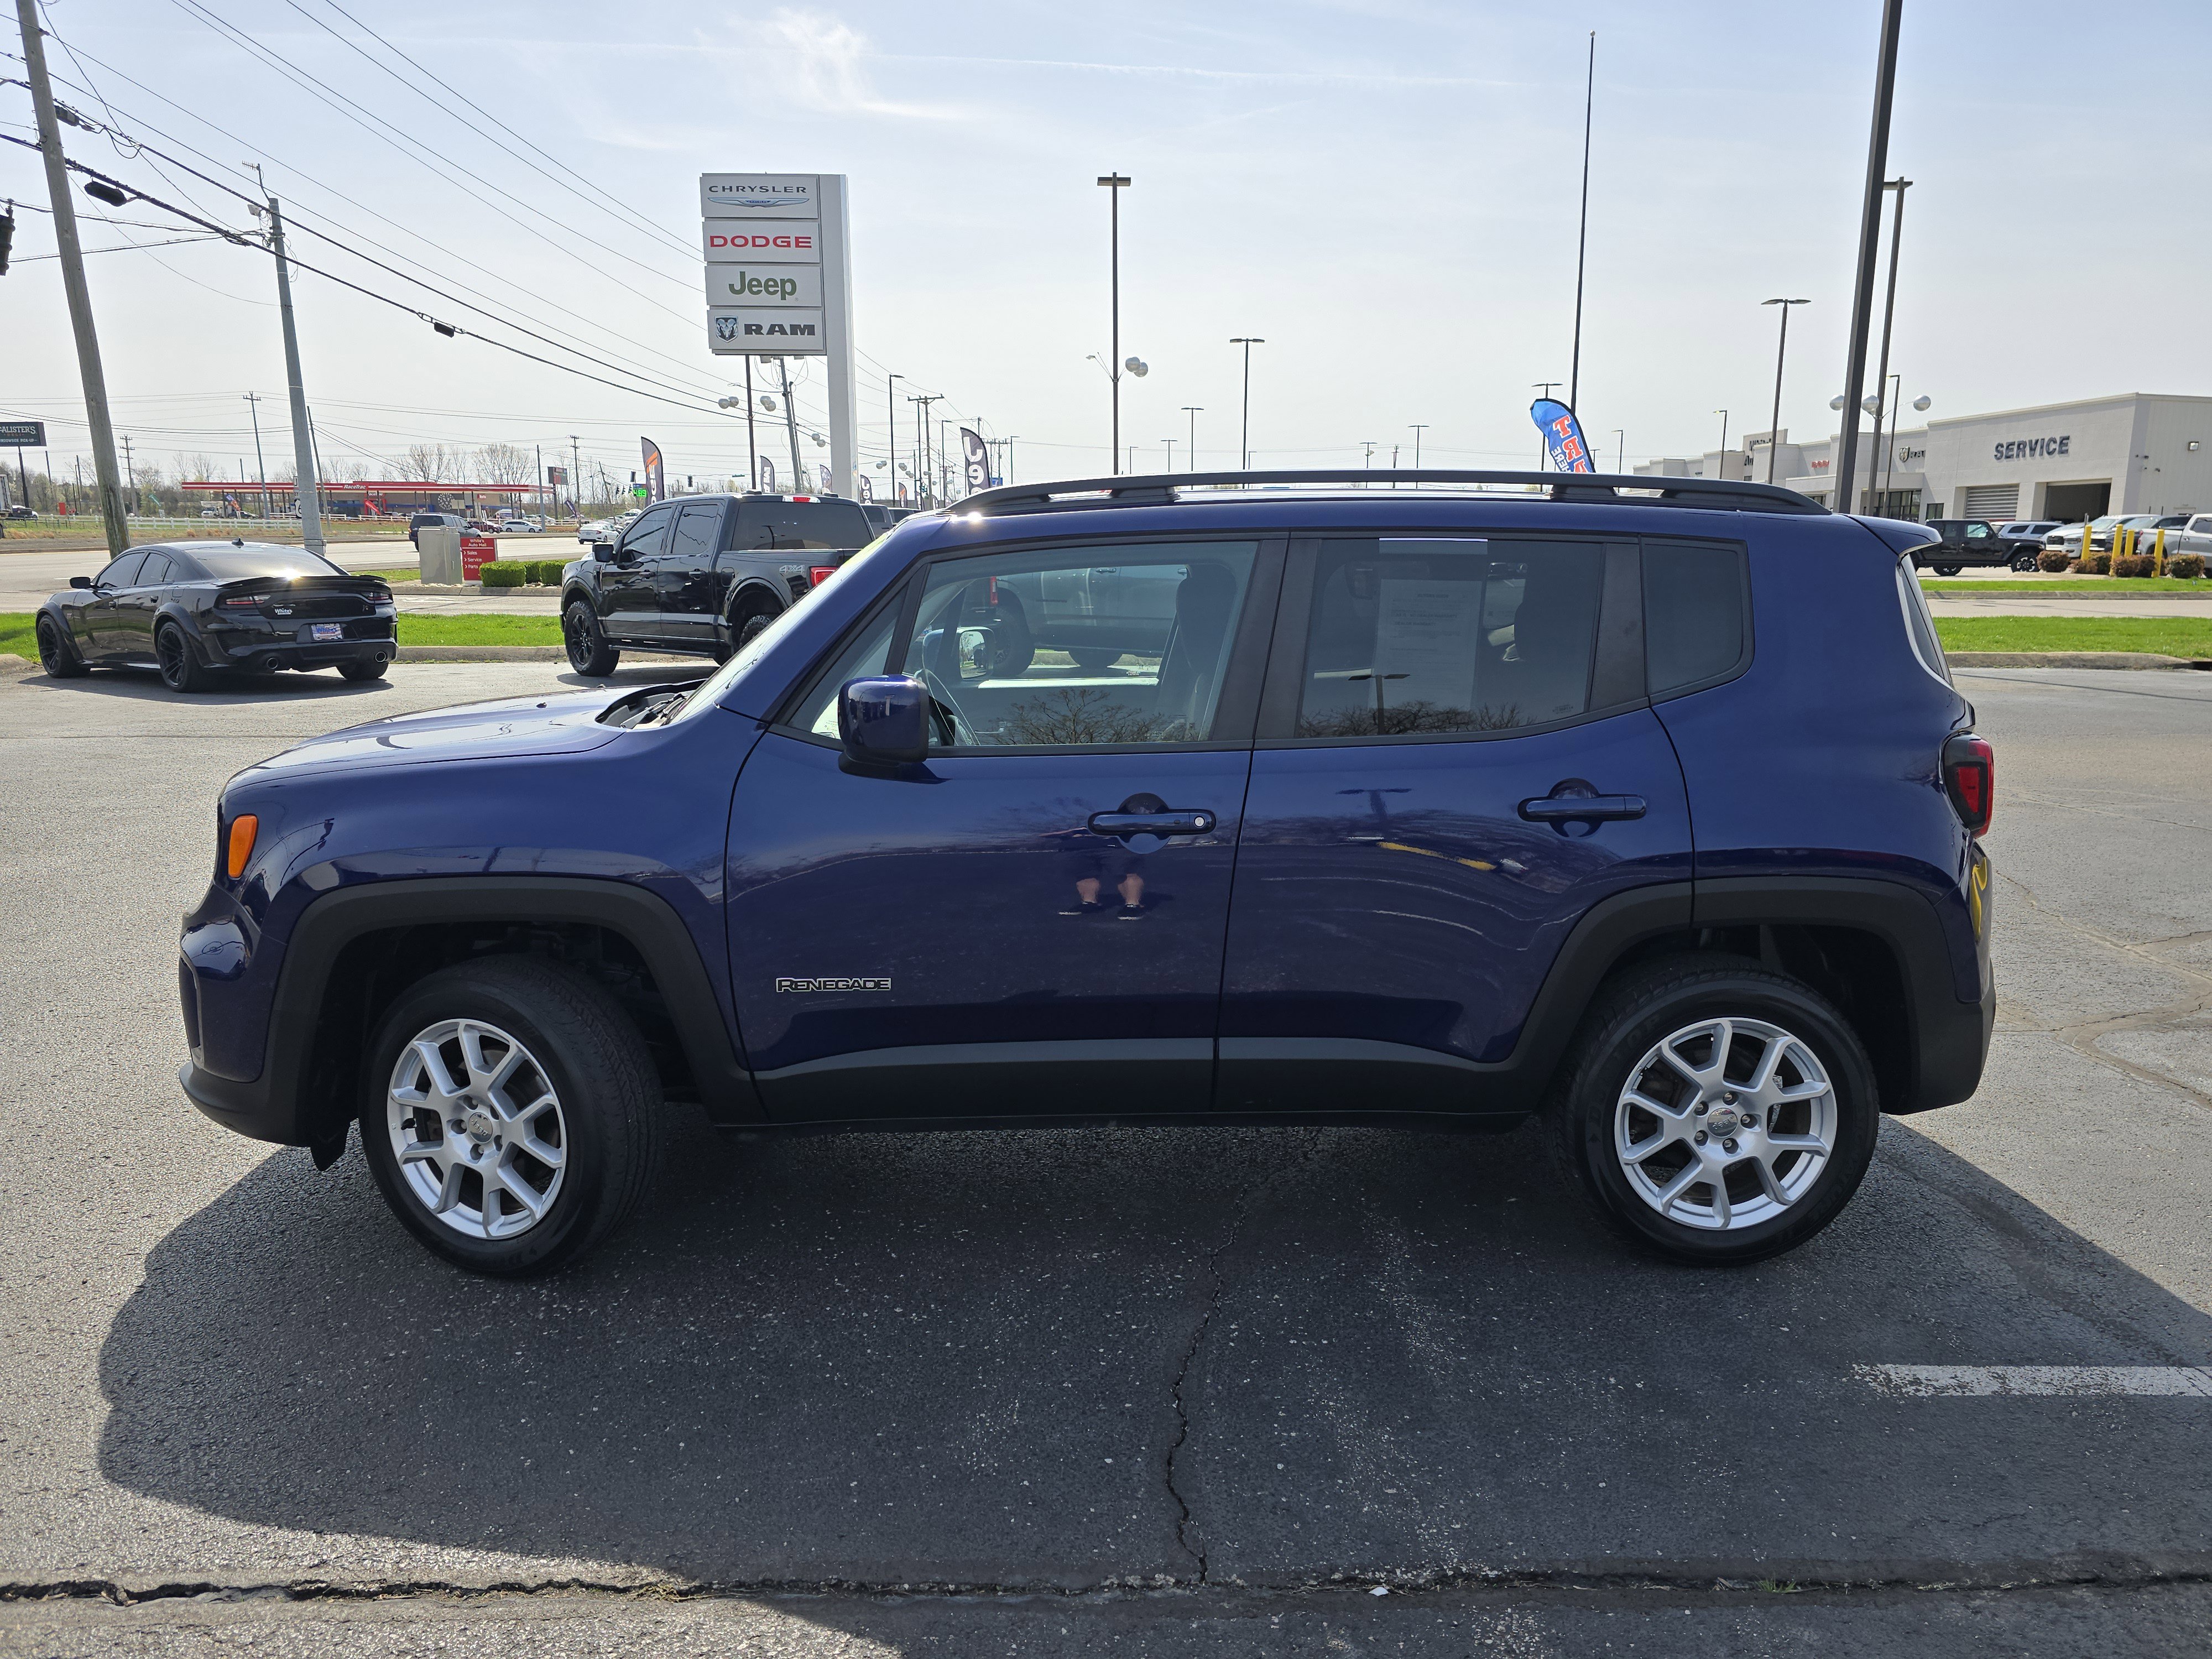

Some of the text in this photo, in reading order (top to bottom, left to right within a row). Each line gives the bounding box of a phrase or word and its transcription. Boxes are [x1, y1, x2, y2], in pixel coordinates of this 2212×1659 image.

[709, 236, 812, 248] DODGE
[728, 271, 797, 300] Jeep
[744, 324, 815, 336] RAM
[1994, 435, 2070, 460] SERVICE
[776, 978, 891, 992] RENEGADE
